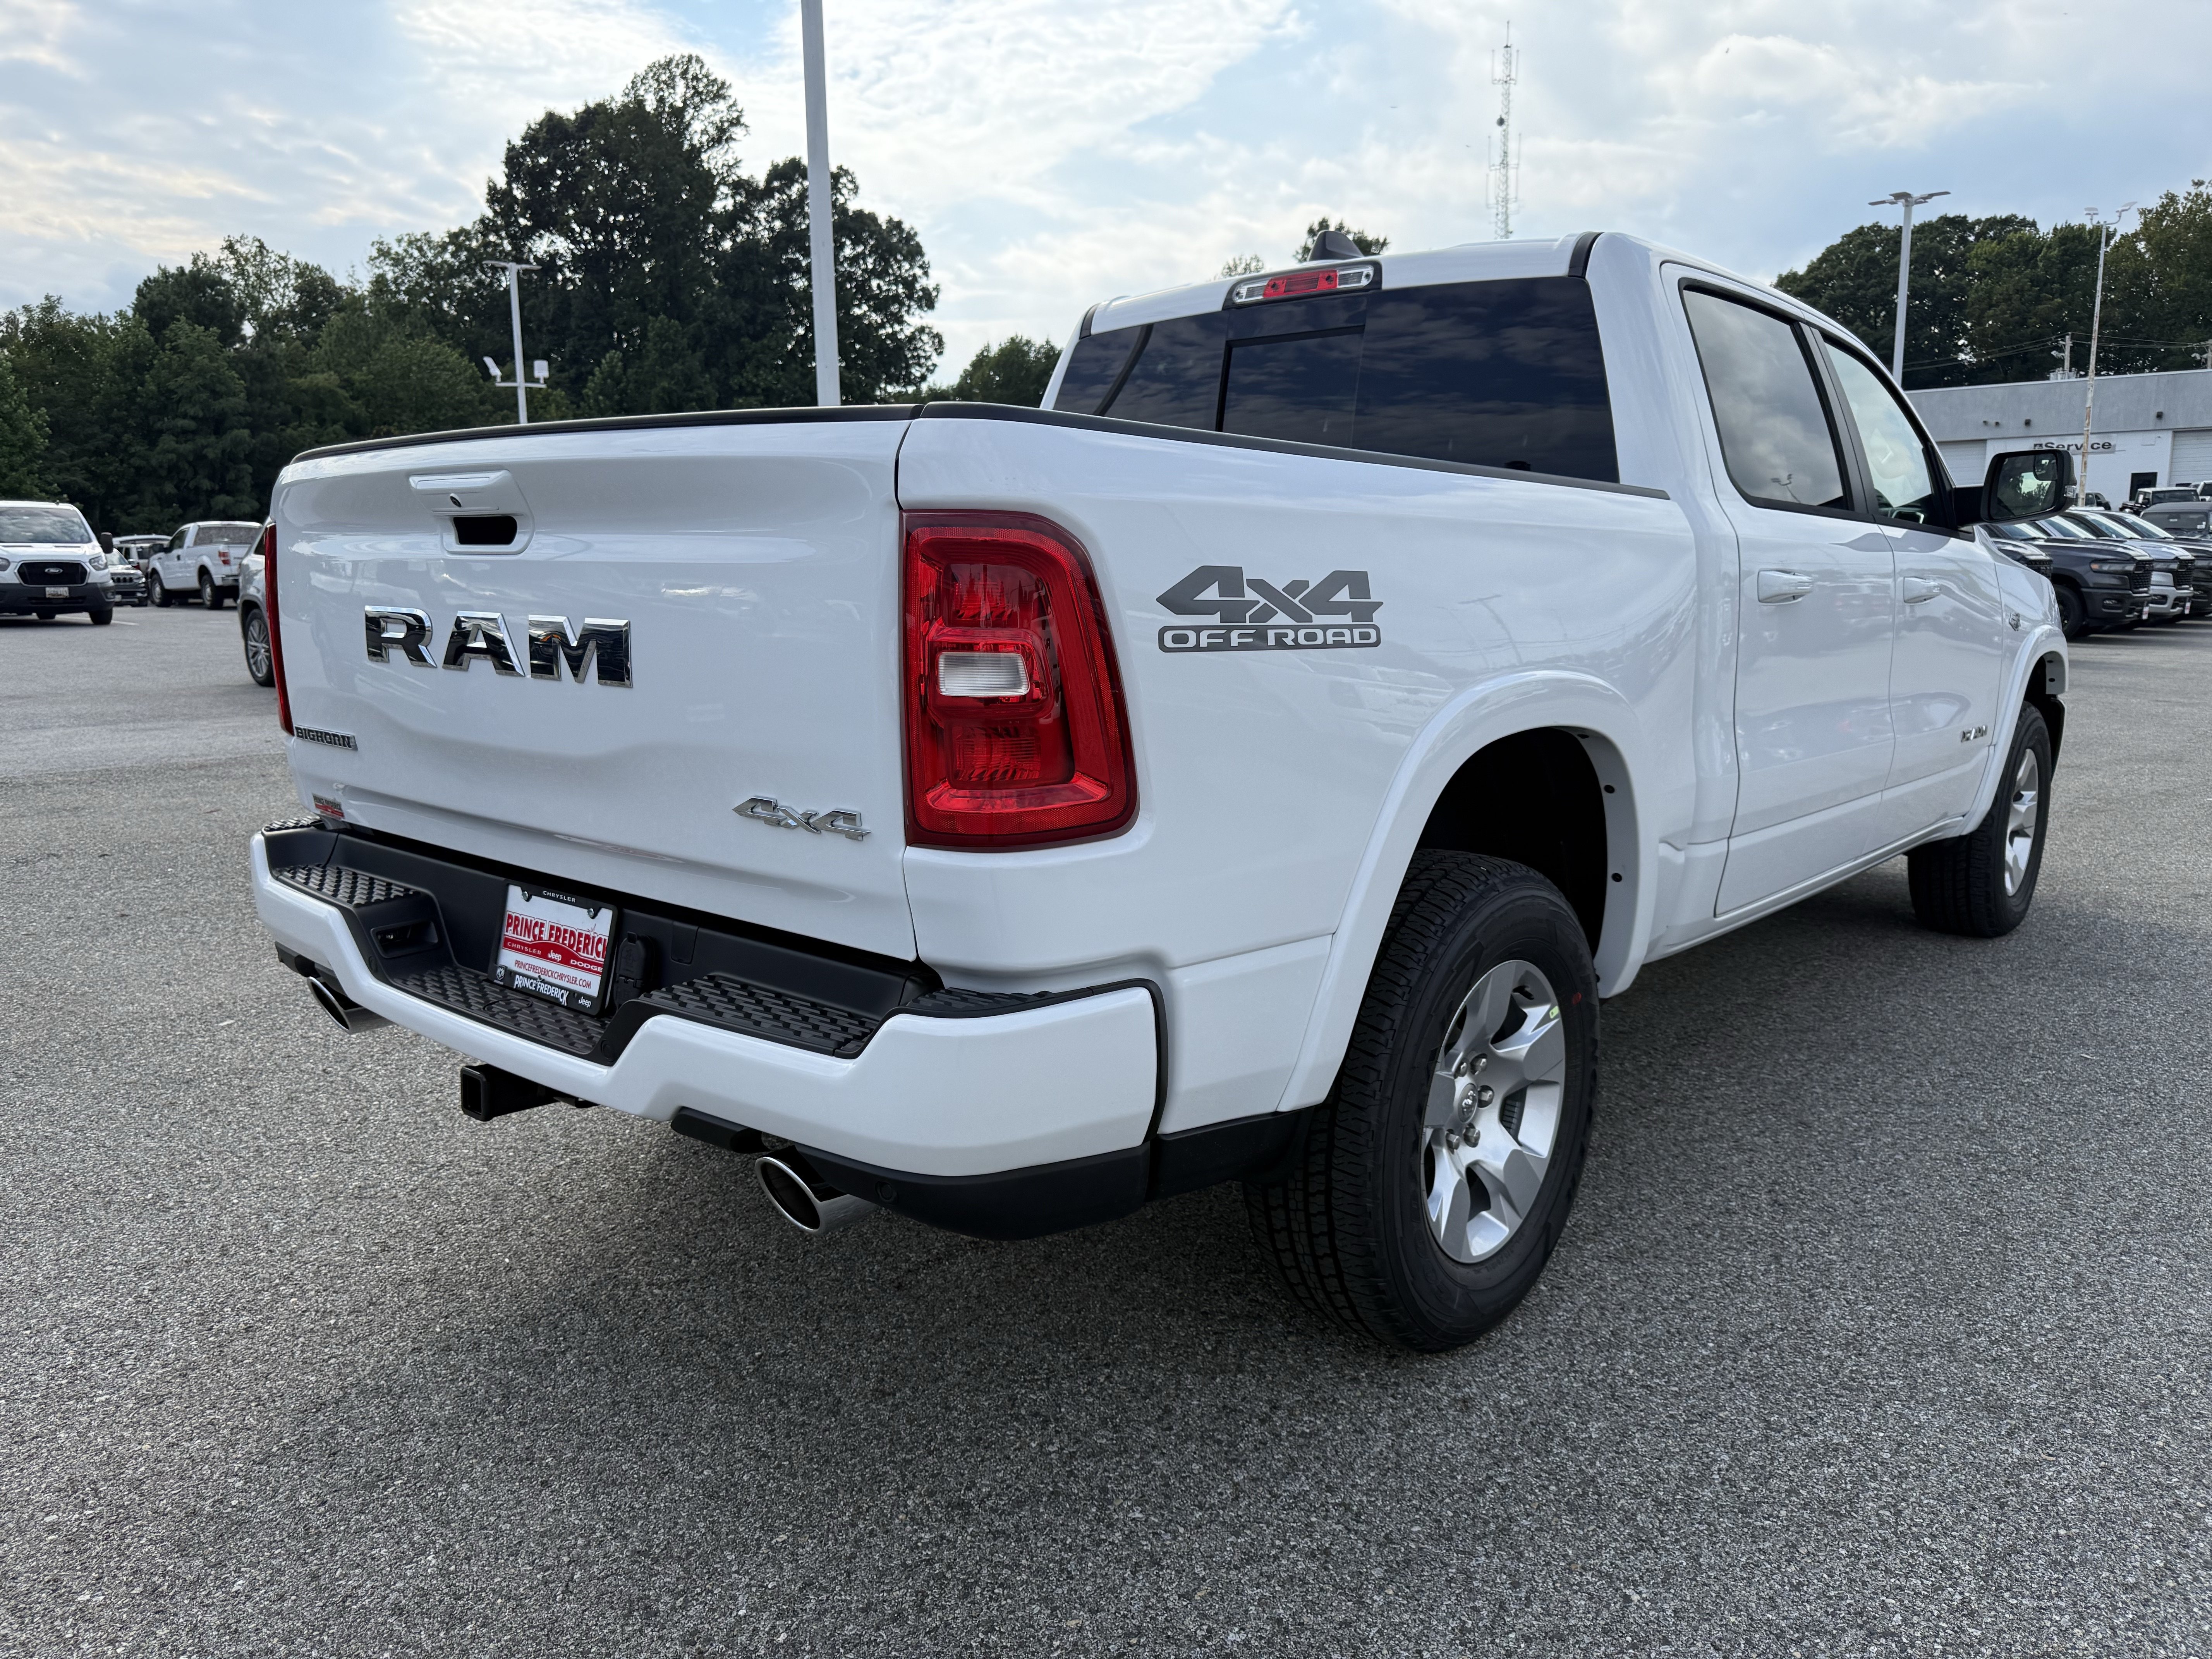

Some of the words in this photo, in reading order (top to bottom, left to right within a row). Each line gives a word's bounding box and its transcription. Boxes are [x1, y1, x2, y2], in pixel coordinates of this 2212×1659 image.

[2045, 441, 2112, 450] Servce
[365, 605, 633, 688] RAM
[1164, 629, 1257, 648] OFF
[1267, 628, 1377, 646] ROAD
[543, 891, 576, 903] CHRYSLER
[505, 913, 545, 941] PRINCE
[508, 942, 541, 955] CHRYSLER
[548, 950, 562, 962] Jeep
[570, 959, 603, 972] DODGE
[514, 974, 537, 991] PRINCE
[536, 982, 569, 1006] FREDERICK
[579, 996, 592, 1008] Jeep
